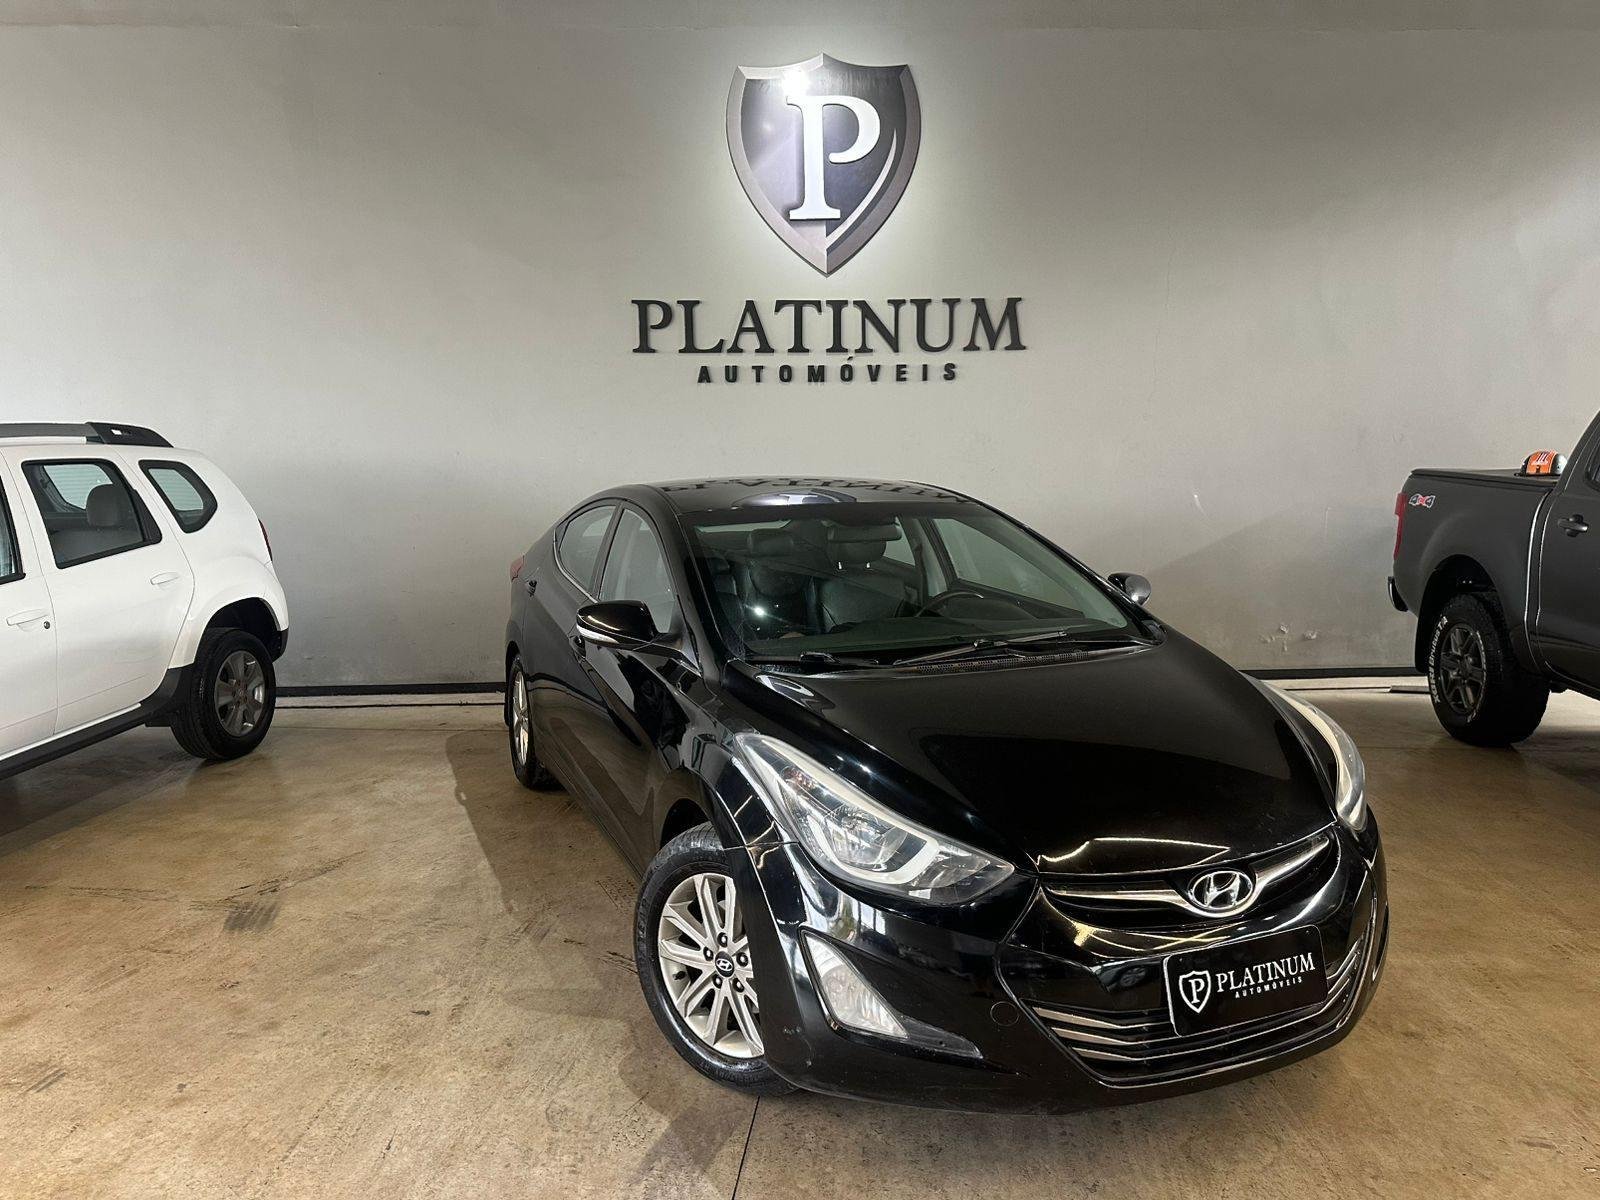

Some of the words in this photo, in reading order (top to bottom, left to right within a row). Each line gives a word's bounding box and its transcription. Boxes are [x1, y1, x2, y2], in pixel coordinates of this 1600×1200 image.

[786, 94, 881, 220] P
[631, 297, 1026, 354] PLATINUM
[698, 356, 957, 383] AUTOMÓVEIS
[1189, 978, 1205, 1003] P
[1216, 952, 1315, 992] PLATINUM
